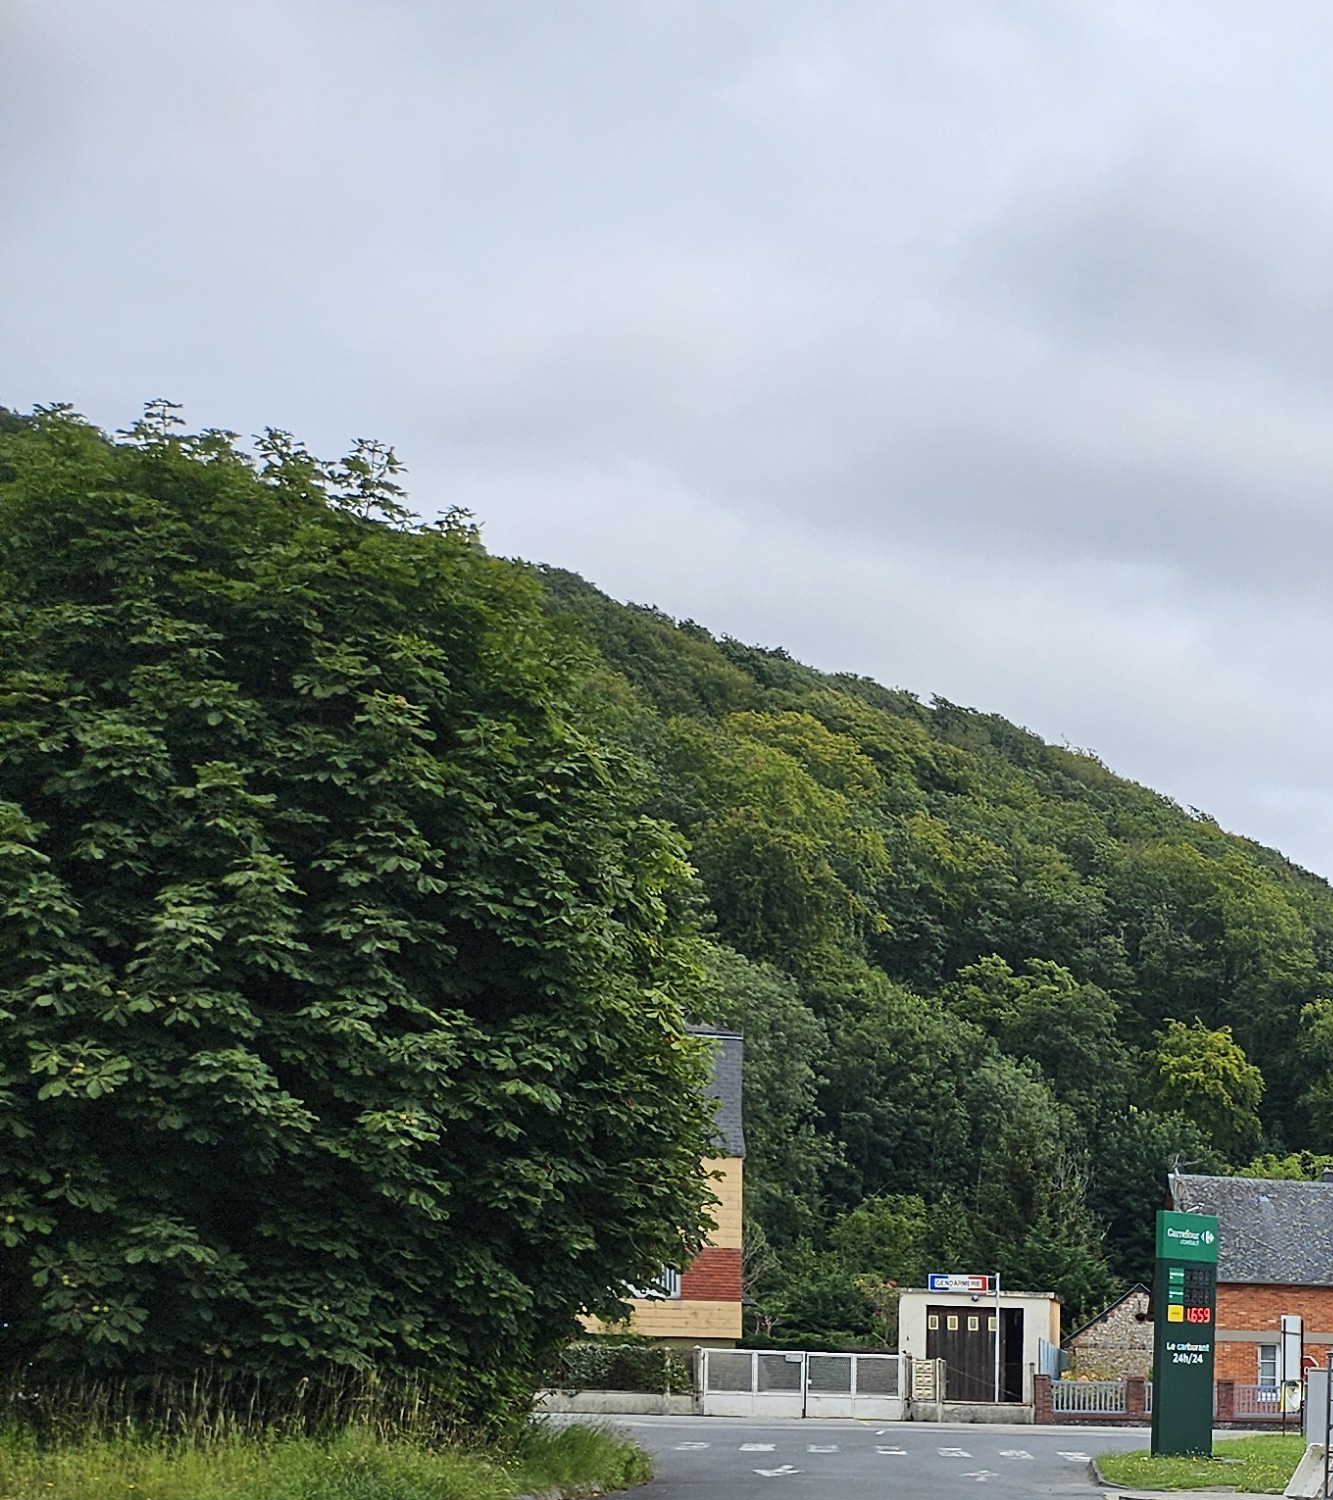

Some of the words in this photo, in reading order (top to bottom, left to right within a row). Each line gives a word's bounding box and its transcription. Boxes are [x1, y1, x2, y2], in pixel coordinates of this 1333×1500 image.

[1167, 1227, 1200, 1239] Carrefour
[1166, 1342, 1176, 1351] Le
[1177, 1342, 1210, 1352] carburant
[1172, 1352, 1203, 1365] 24h/24
